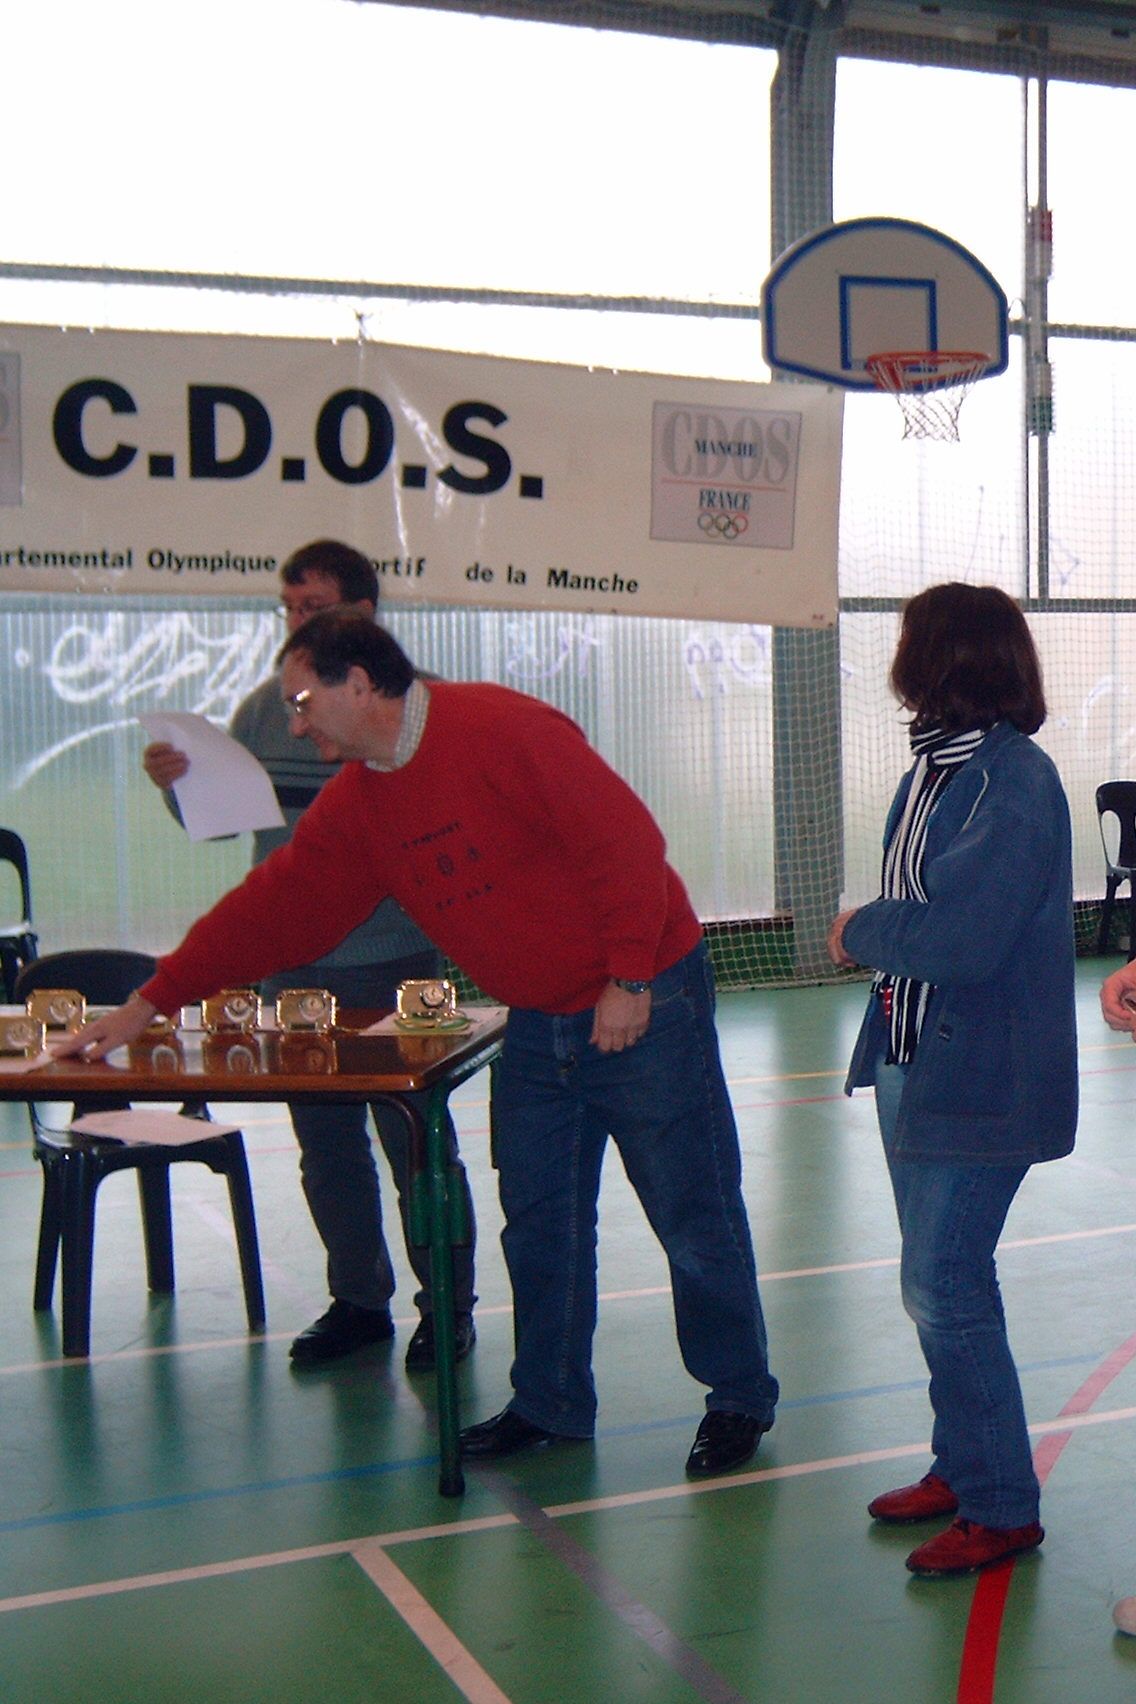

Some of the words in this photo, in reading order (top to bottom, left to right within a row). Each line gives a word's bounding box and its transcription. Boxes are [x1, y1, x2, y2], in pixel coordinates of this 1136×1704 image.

[661, 410, 792, 484] CDOS
[695, 439, 757, 458] MANCHE
[700, 487, 750, 513] FRANCE
[0, 546, 132, 569] rtemental
[147, 550, 277, 574] Olympique
[465, 562, 494, 583] de
[506, 565, 527, 585] la
[547, 568, 639, 593] Manche
